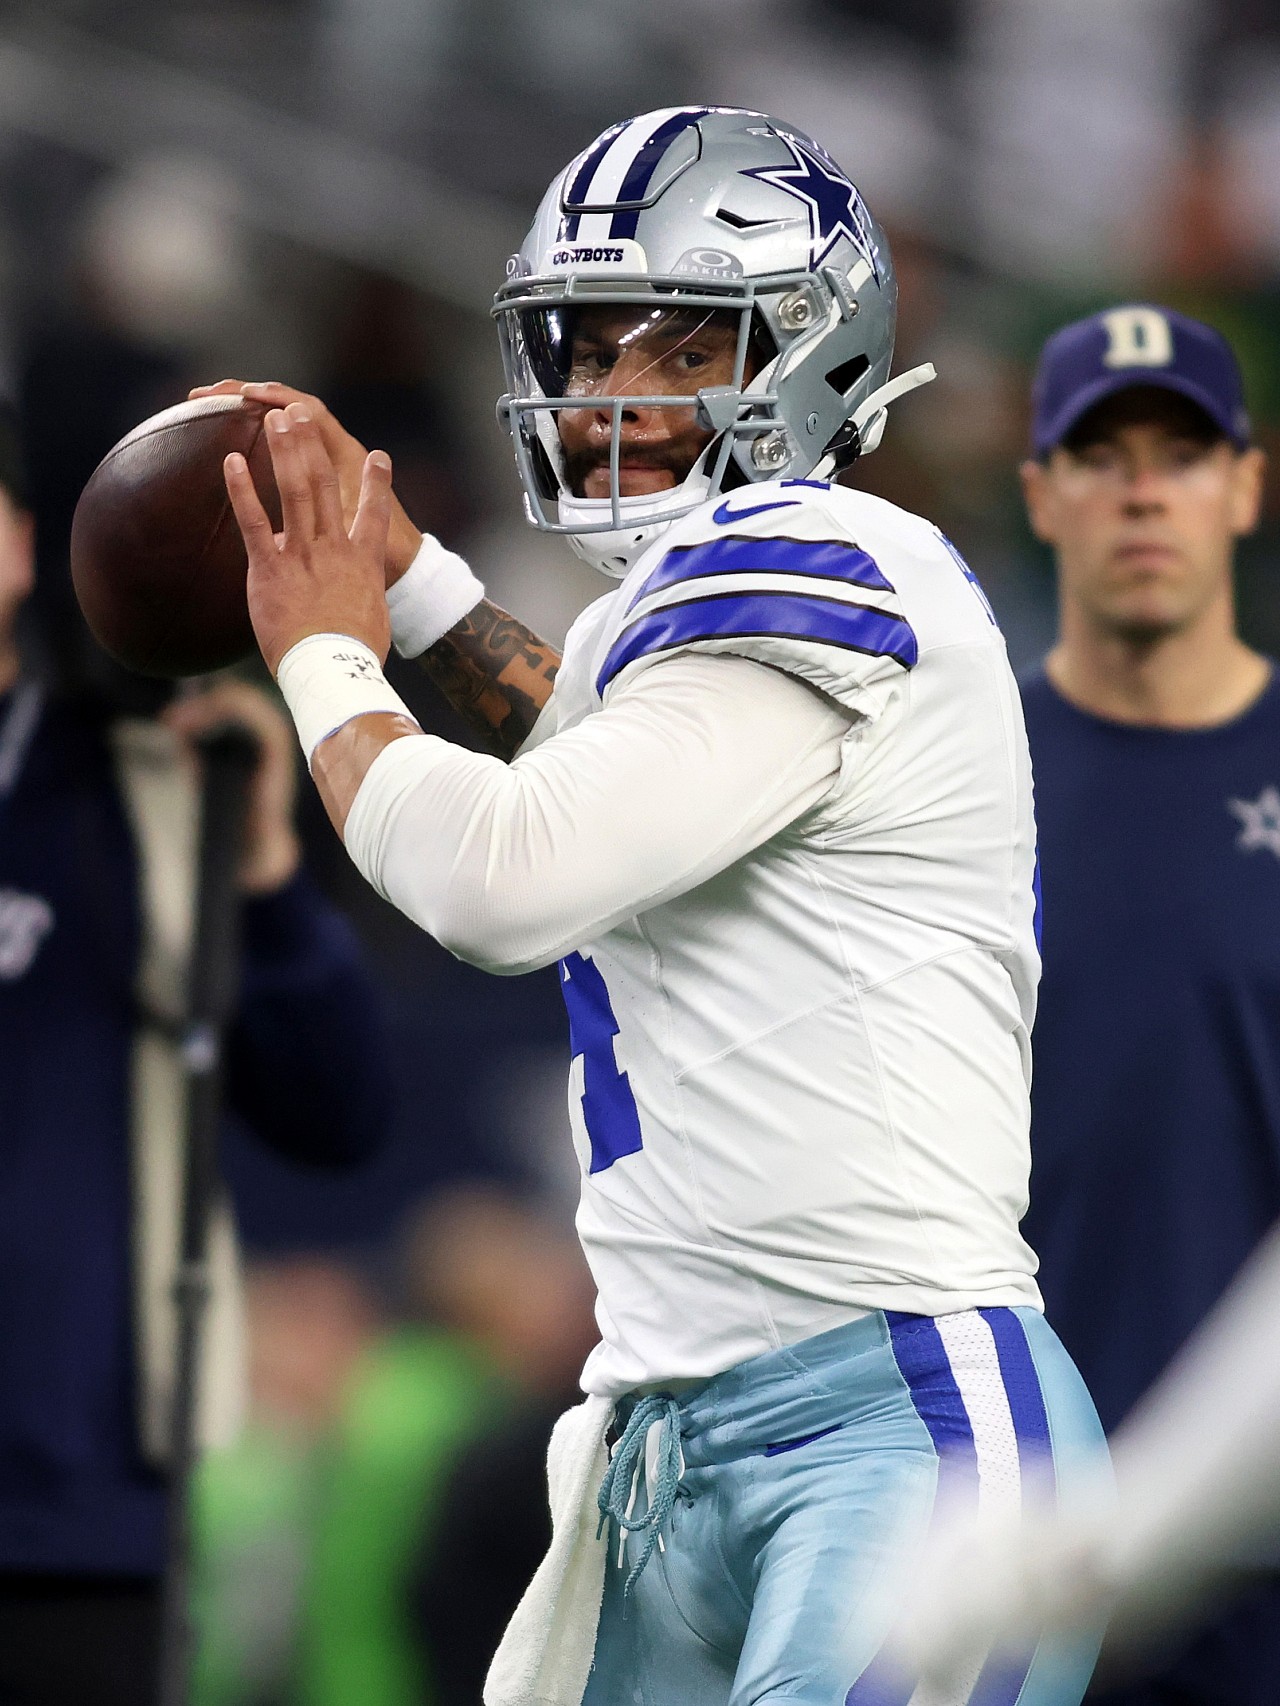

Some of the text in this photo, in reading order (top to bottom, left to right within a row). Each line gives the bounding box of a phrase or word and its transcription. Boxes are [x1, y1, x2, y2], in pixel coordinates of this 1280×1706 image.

[553, 248, 624, 265] COWBOYS
[679, 264, 739, 279] OAKLEY
[1102, 306, 1173, 368] D
